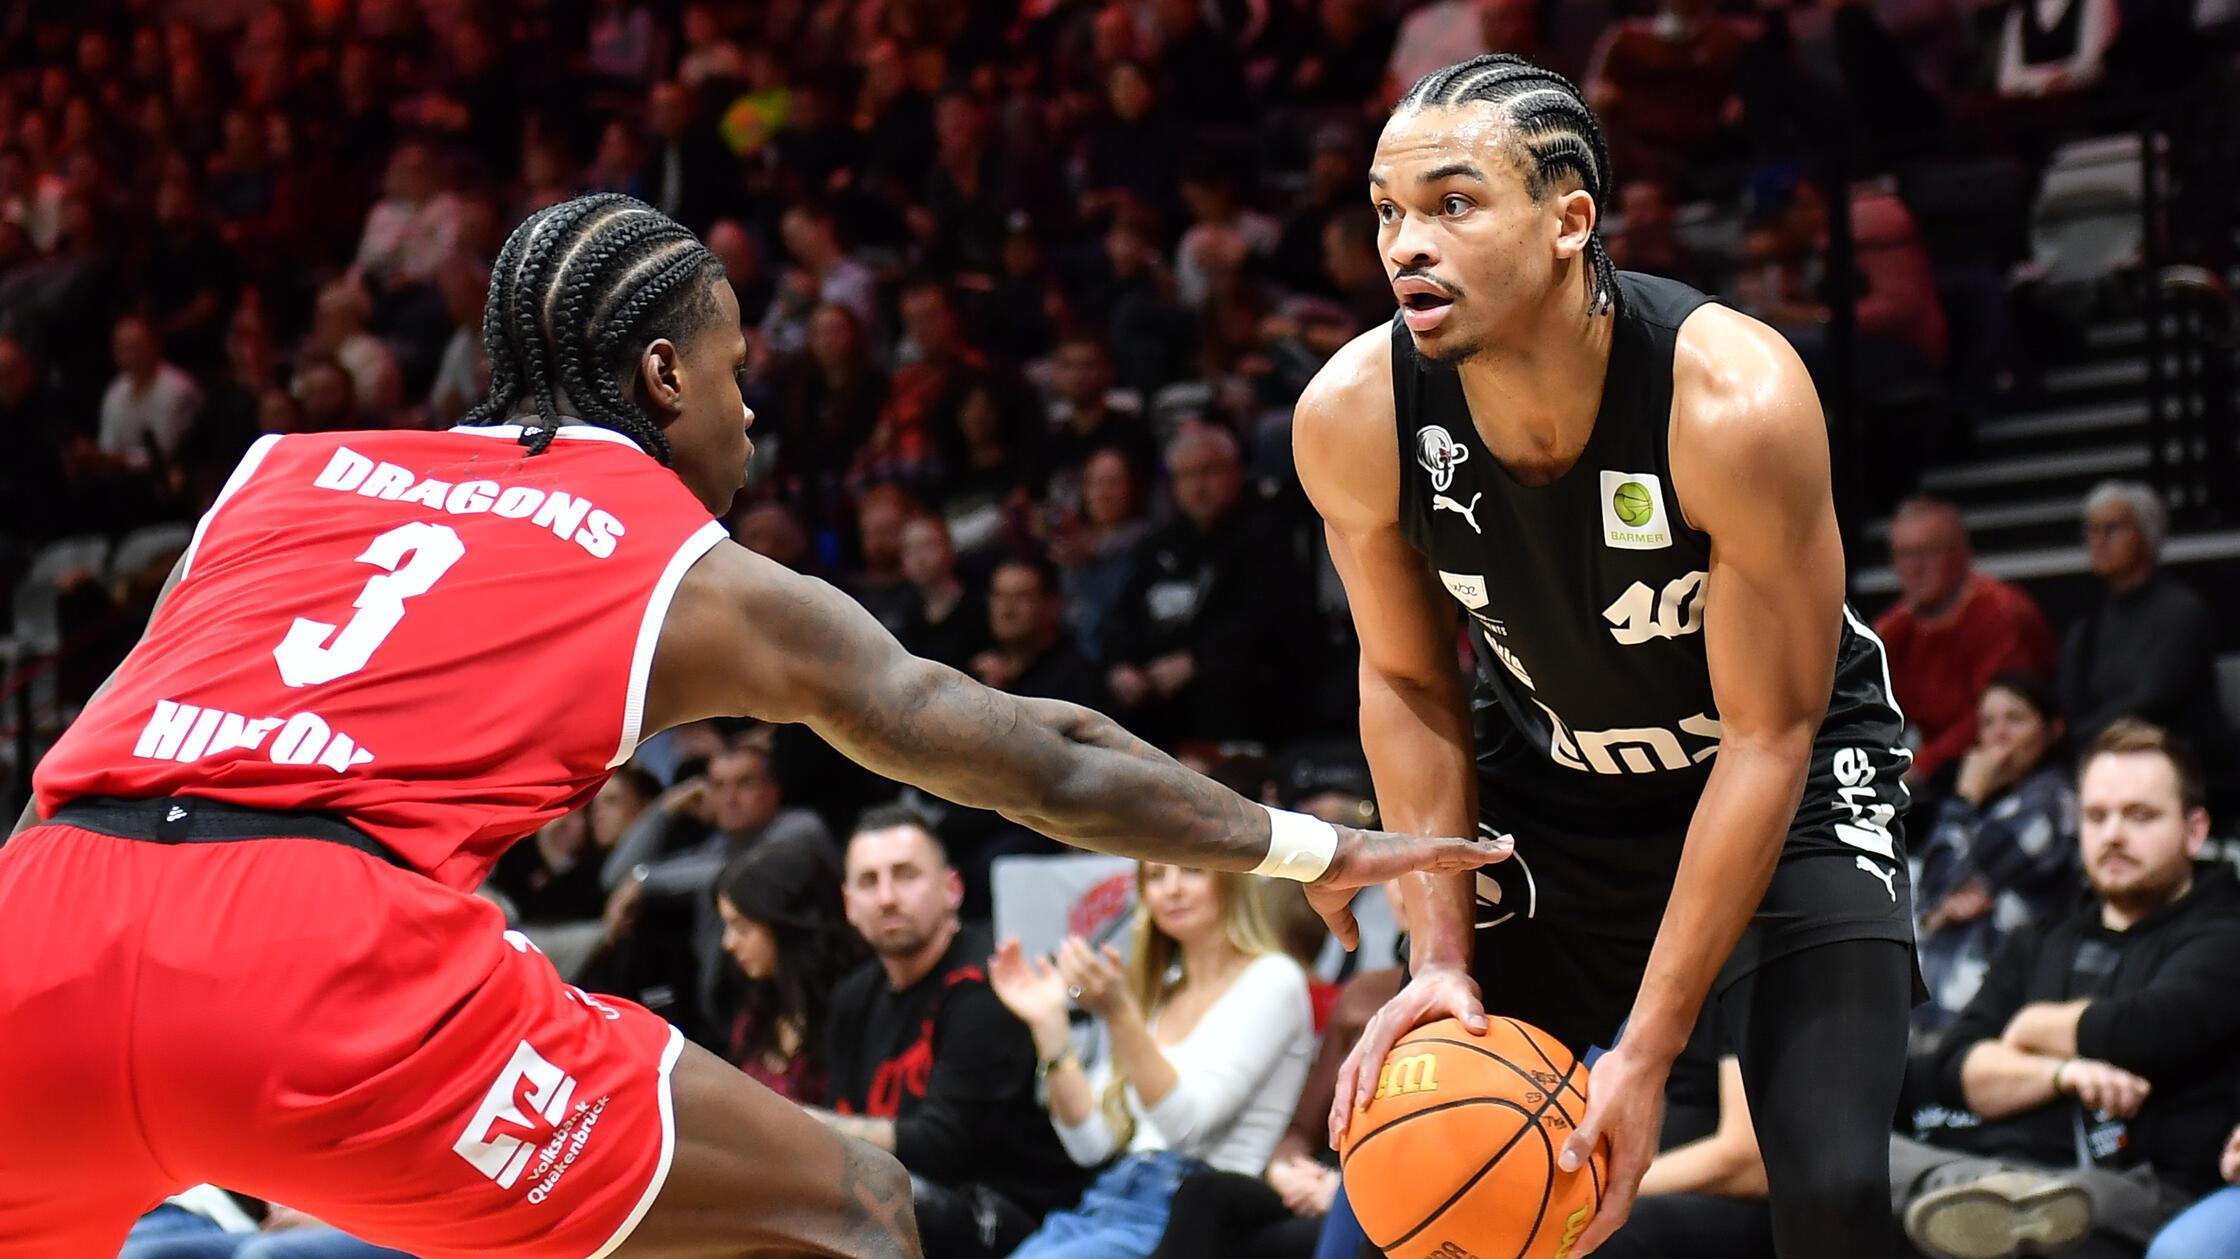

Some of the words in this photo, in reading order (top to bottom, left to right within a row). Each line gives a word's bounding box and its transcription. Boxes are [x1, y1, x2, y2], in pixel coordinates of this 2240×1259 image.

[313, 446, 625, 559] DRAGONS
[1611, 531, 1664, 543] BARMER
[273, 521, 466, 687] 3
[1602, 570, 1711, 645] 10
[527, 1100, 590, 1181] Volksbank
[527, 1095, 610, 1204] Quakenbrück
